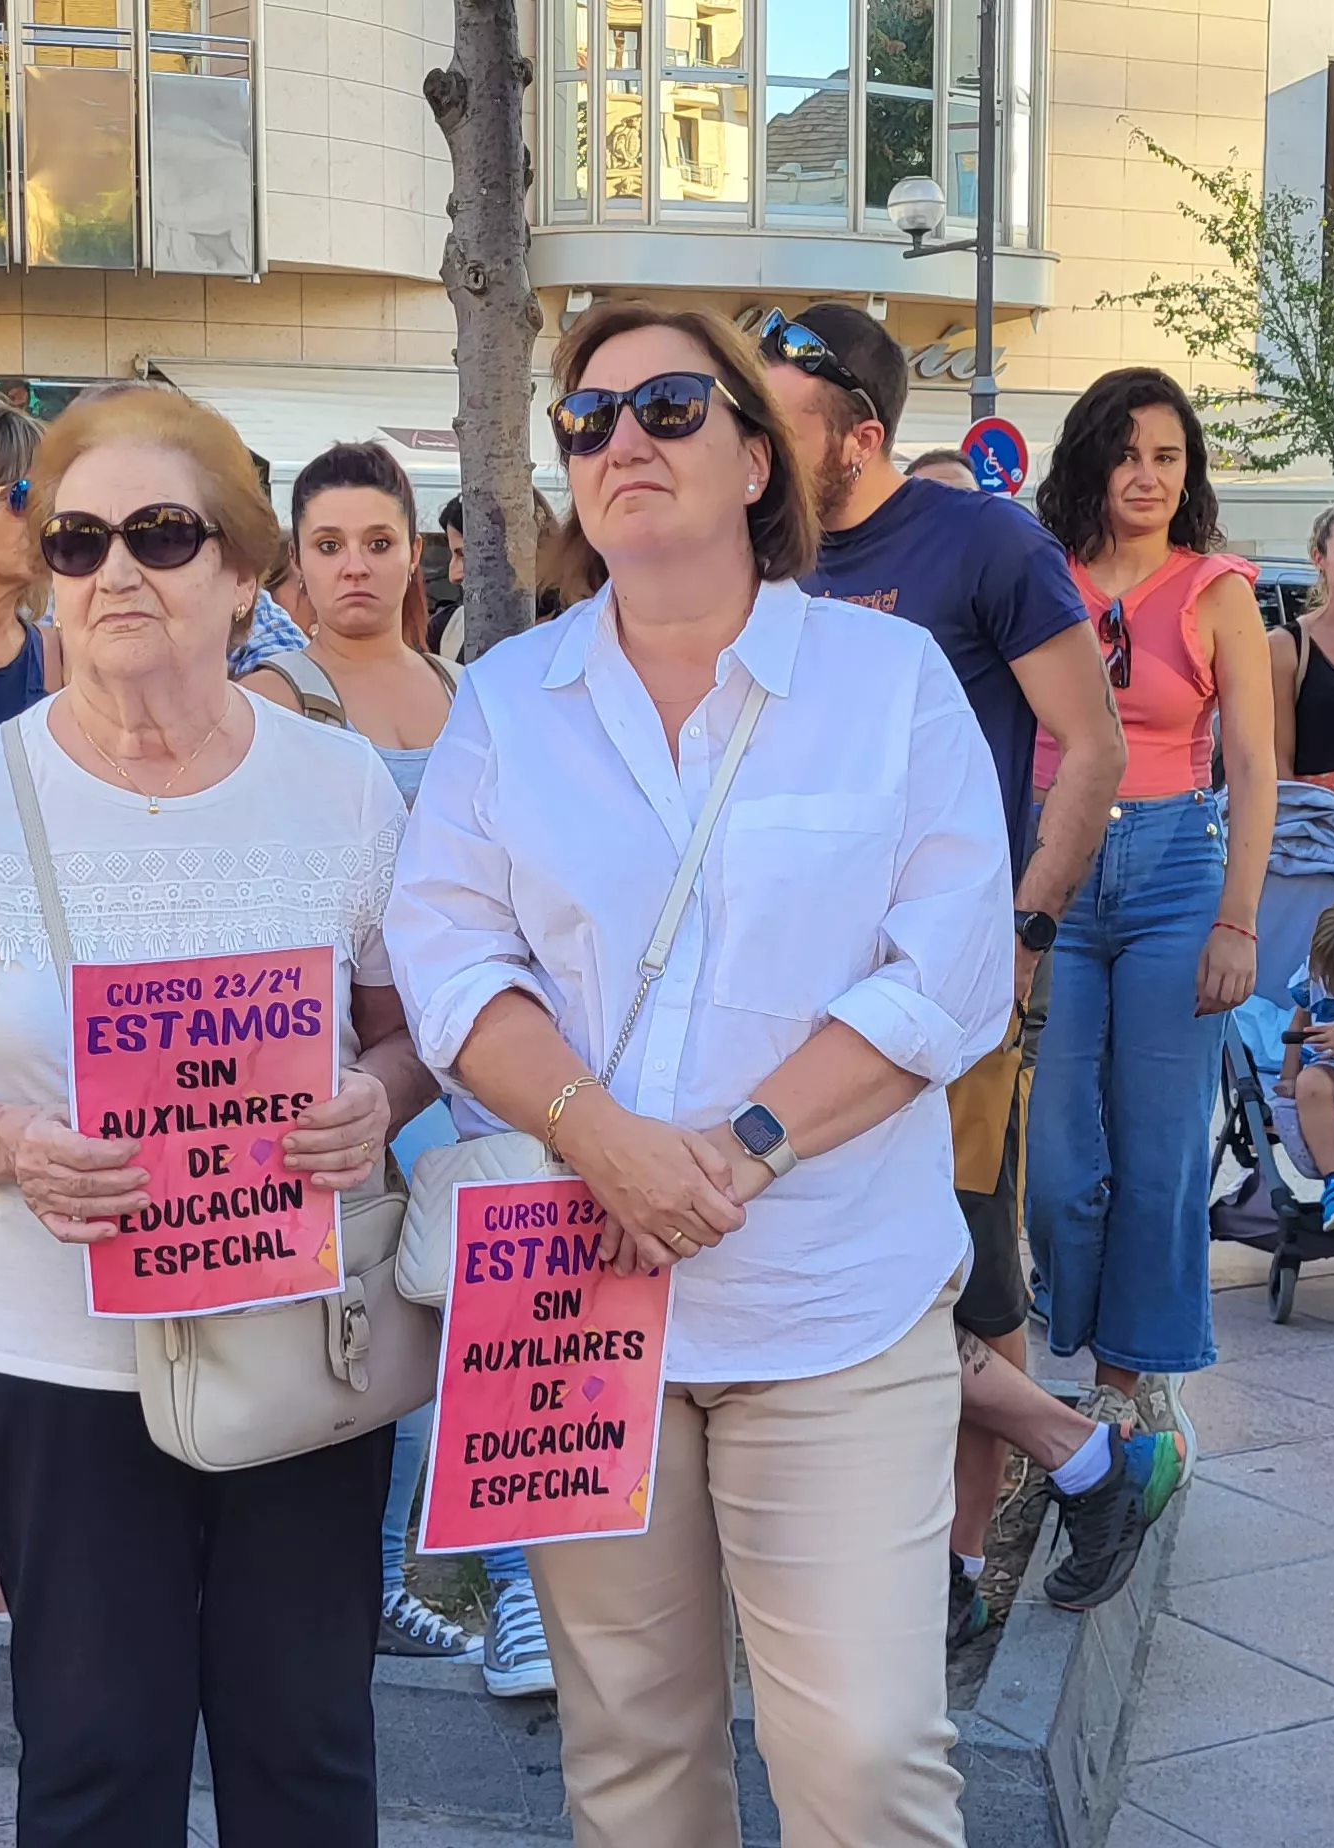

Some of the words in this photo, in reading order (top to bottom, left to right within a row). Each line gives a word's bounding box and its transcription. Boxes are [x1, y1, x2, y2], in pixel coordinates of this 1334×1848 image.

[107, 977, 202, 1007] CURSO
[214, 967, 301, 999] 23/24
[87, 998, 322, 1055] ESTAMOS
[176, 1058, 236, 1089] SIN
[100, 1093, 313, 1139] AUXILIARES
[188, 1144, 231, 1178] DE
[485, 1201, 558, 1232] CURSO
[134, 1229, 296, 1277] ESPECIAL
[465, 1233, 659, 1284] ESTAM
[533, 1288, 581, 1321] SIN
[464, 1331, 645, 1373] AUXILIARES
[530, 1380, 566, 1412] DE
[464, 1411, 625, 1464] EDUCACIÓN
[470, 1466, 609, 1509] ESPECIAL
